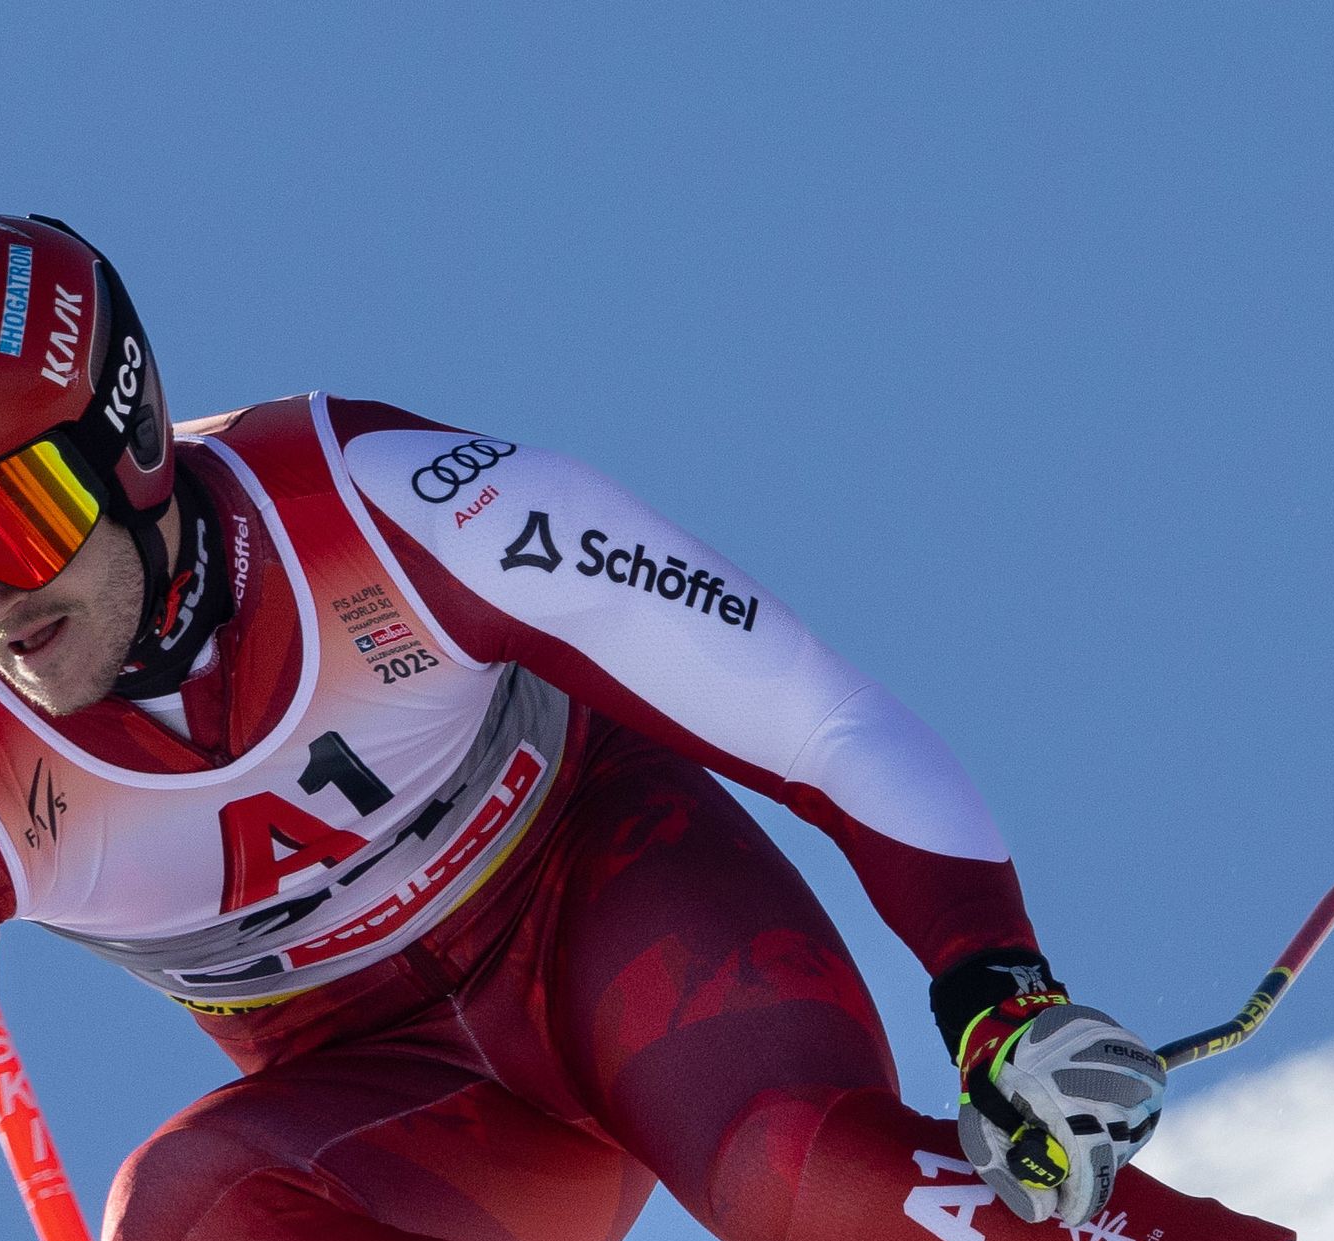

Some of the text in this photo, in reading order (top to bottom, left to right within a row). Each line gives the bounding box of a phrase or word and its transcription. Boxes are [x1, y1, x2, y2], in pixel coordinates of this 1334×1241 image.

[41, 284, 83, 388] KASK
[454, 485, 501, 529] Audi
[332, 599, 351, 612] FIS
[339, 602, 378, 623] WORLD
[373, 648, 440, 685] 2025
[219, 730, 395, 915] A1
[1020, 1157, 1057, 1182] LEKI
